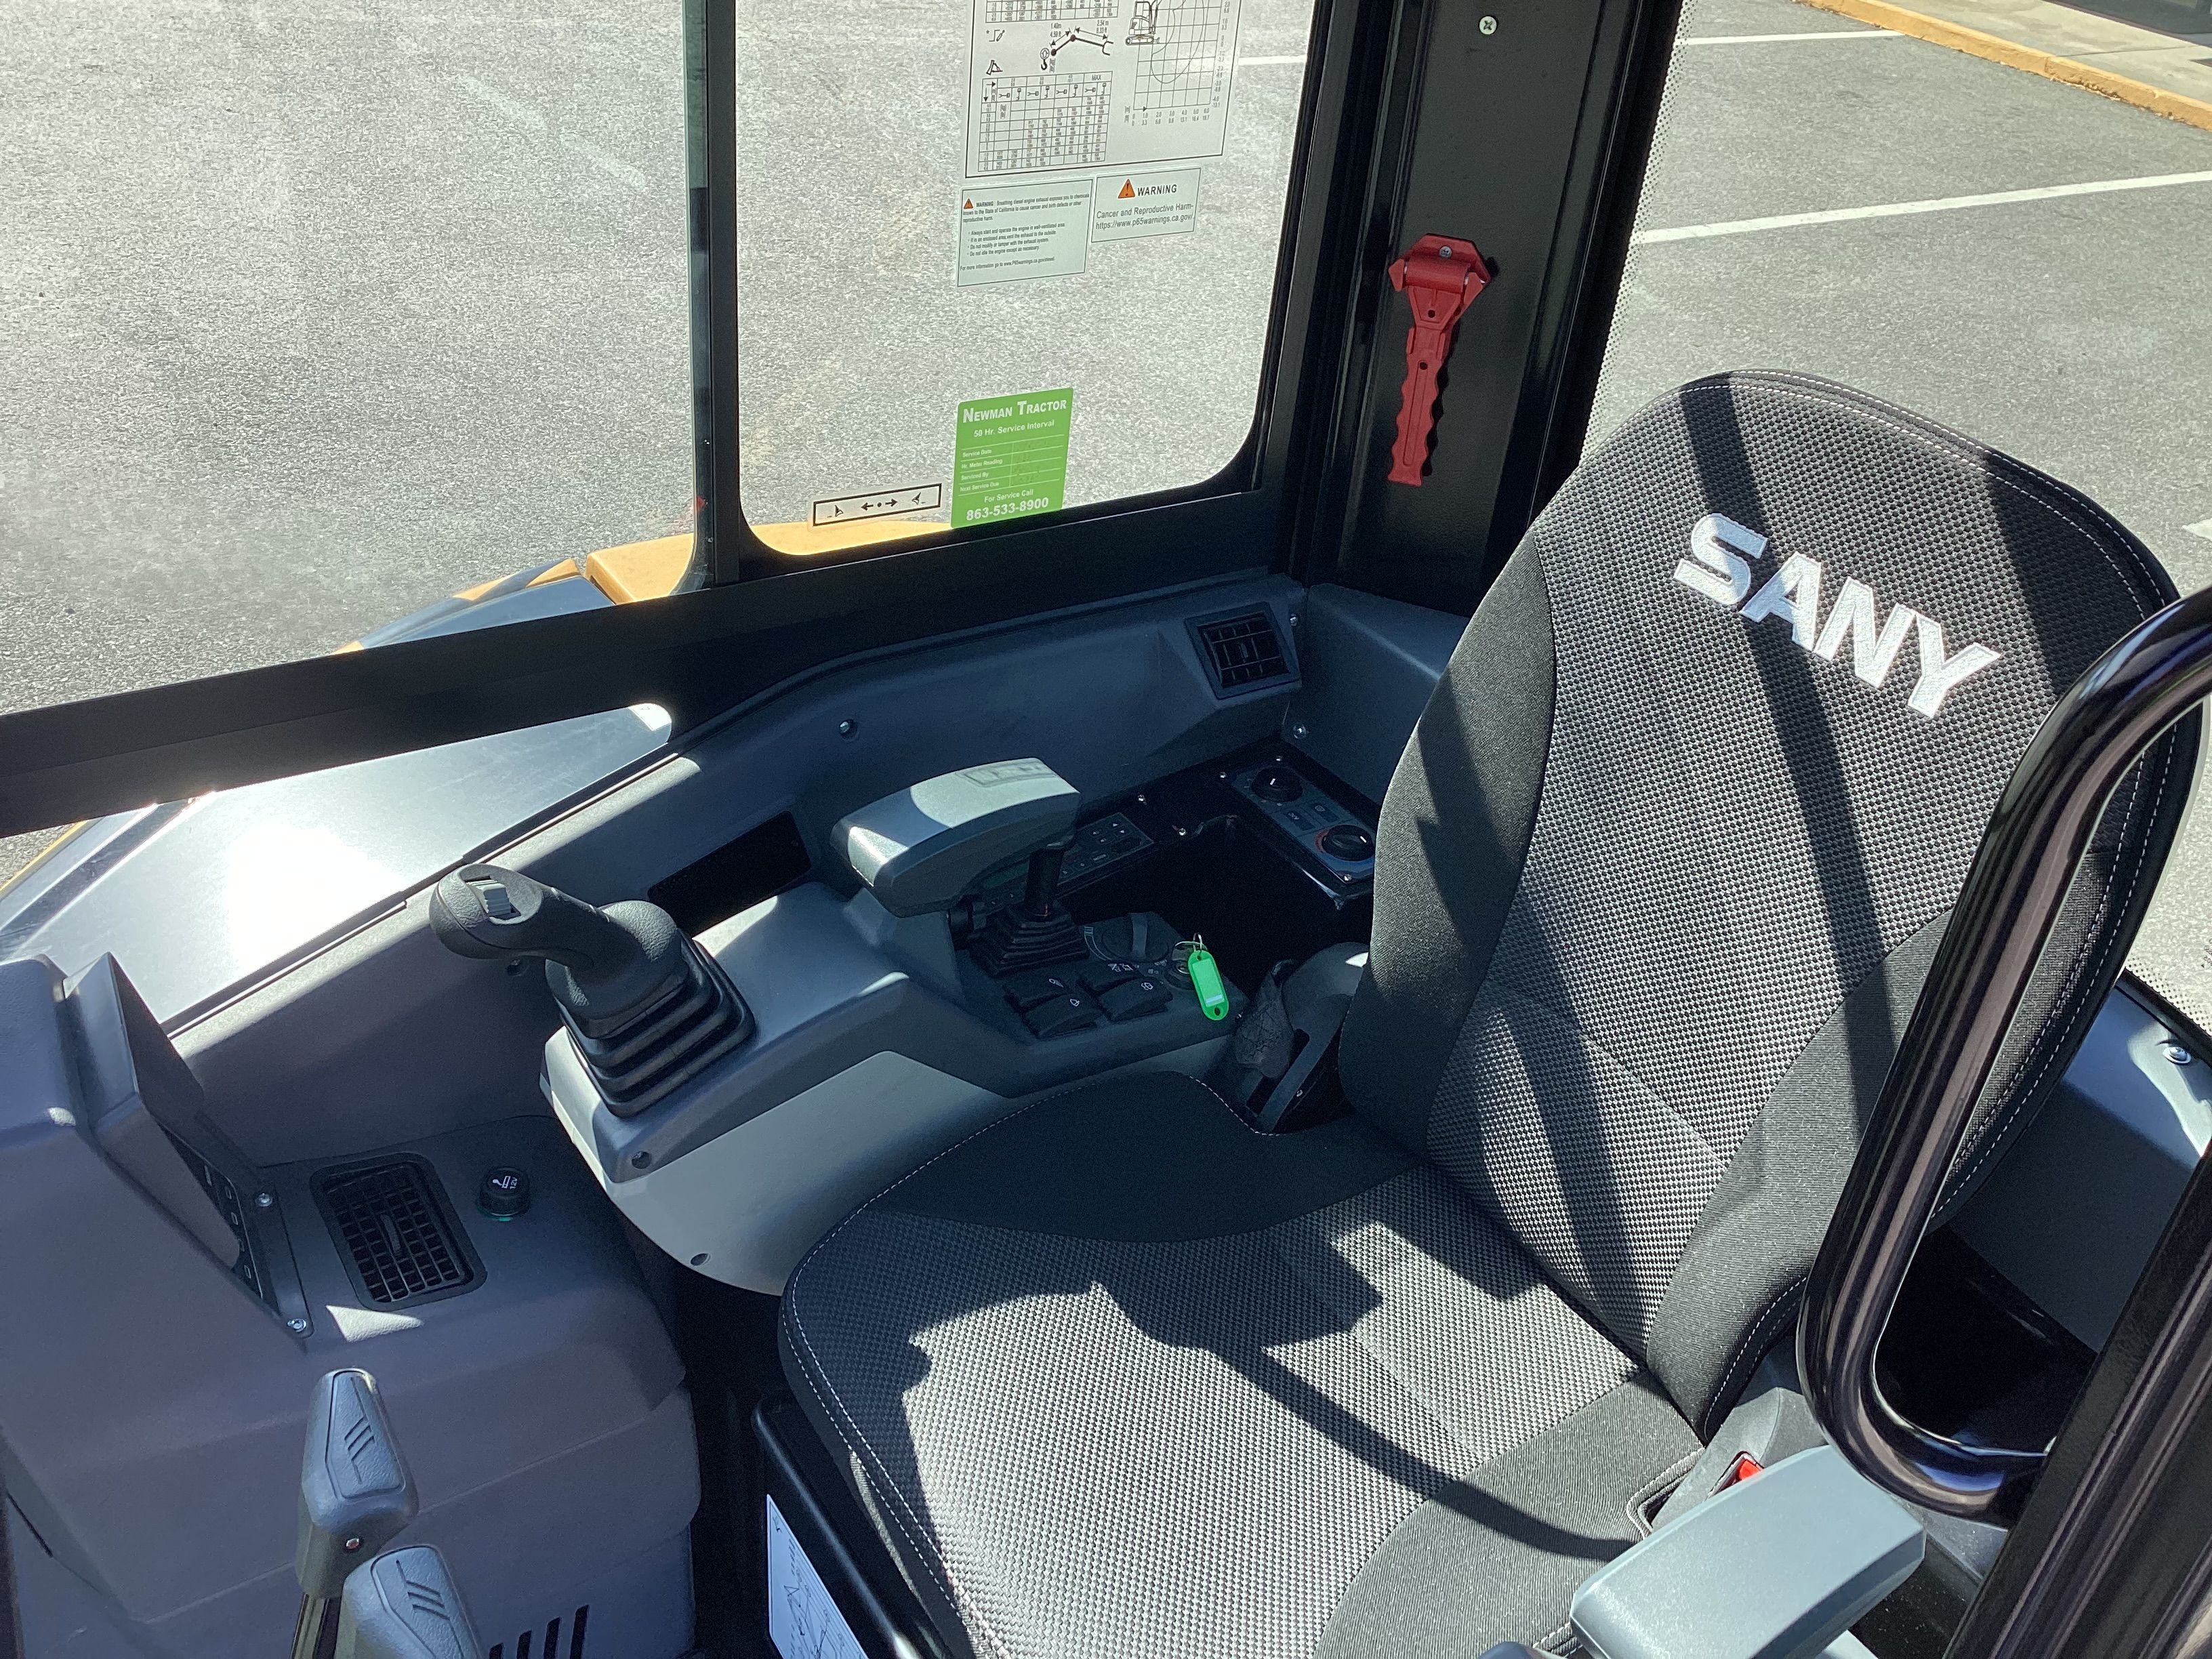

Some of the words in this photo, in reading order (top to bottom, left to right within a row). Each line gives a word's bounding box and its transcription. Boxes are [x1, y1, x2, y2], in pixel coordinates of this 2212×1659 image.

[1137, 184, 1177, 197] WARNING
[1097, 210, 1119, 219] Cancer
[1120, 208, 1132, 217] and
[1133, 205, 1174, 216] Reproductive
[962, 407, 1013, 424] NEWMAN
[1017, 399, 1067, 415] TRACTOR
[973, 429, 983, 438] 50
[985, 428, 996, 436] Hr.
[998, 424, 1025, 434] Service
[1027, 419, 1054, 430] Interval
[997, 491, 1020, 501] Service
[1021, 489, 1033, 497] Call
[966, 497, 1049, 521] 863-533-8900
[1673, 512, 2003, 720] SANY
